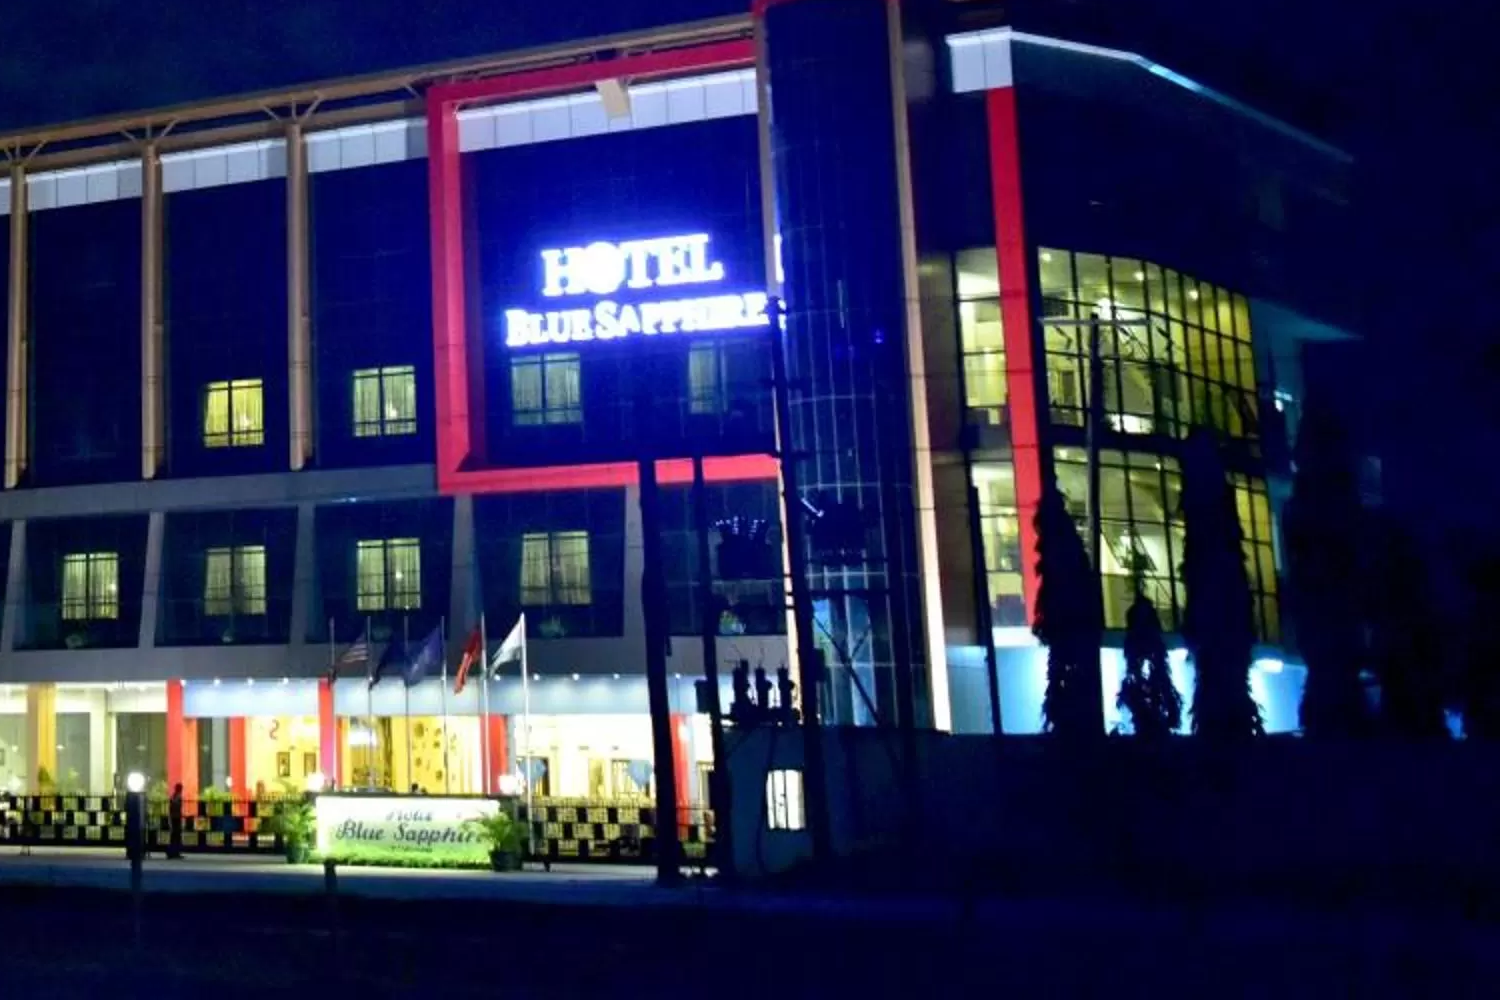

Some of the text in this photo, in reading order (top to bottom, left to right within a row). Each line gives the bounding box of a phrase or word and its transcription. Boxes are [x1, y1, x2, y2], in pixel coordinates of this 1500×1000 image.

[541, 233, 724, 296] HOTEL
[505, 309, 593, 346] BLUE
[335, 817, 385, 842] Blue
